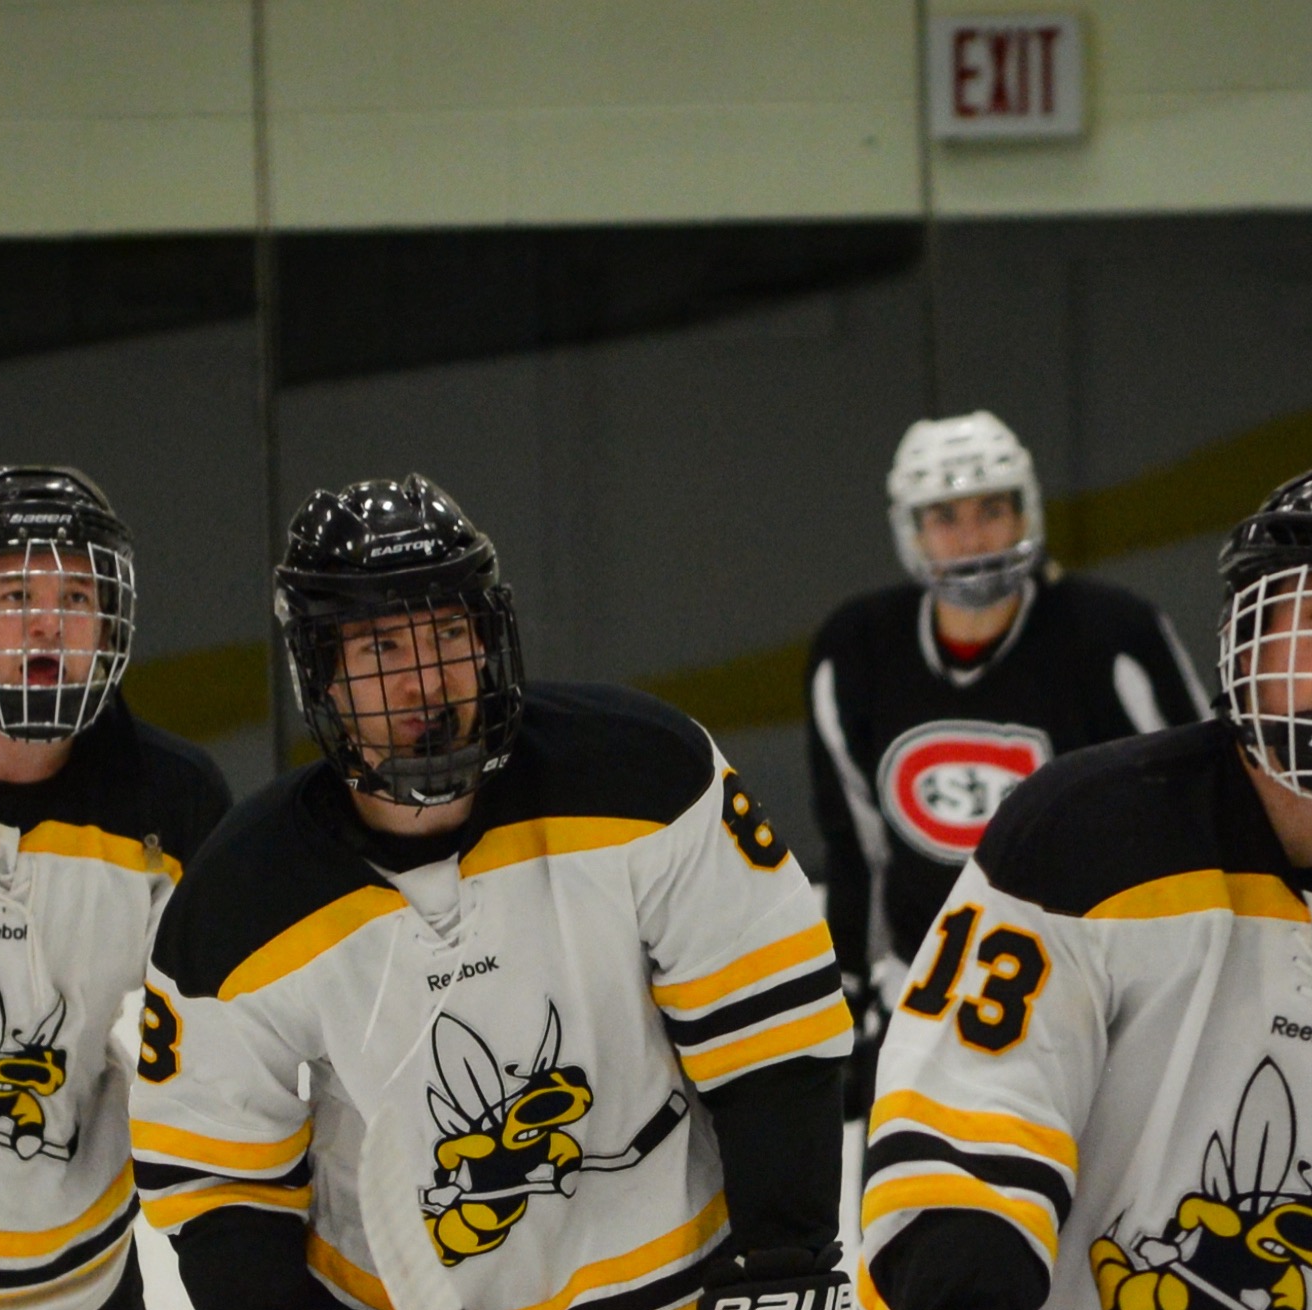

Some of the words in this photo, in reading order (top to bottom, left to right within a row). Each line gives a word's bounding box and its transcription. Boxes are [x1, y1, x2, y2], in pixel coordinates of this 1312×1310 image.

[952, 26, 1061, 120] EXIT
[370, 538, 437, 558] EASTON
[899, 902, 1052, 1056] 13
